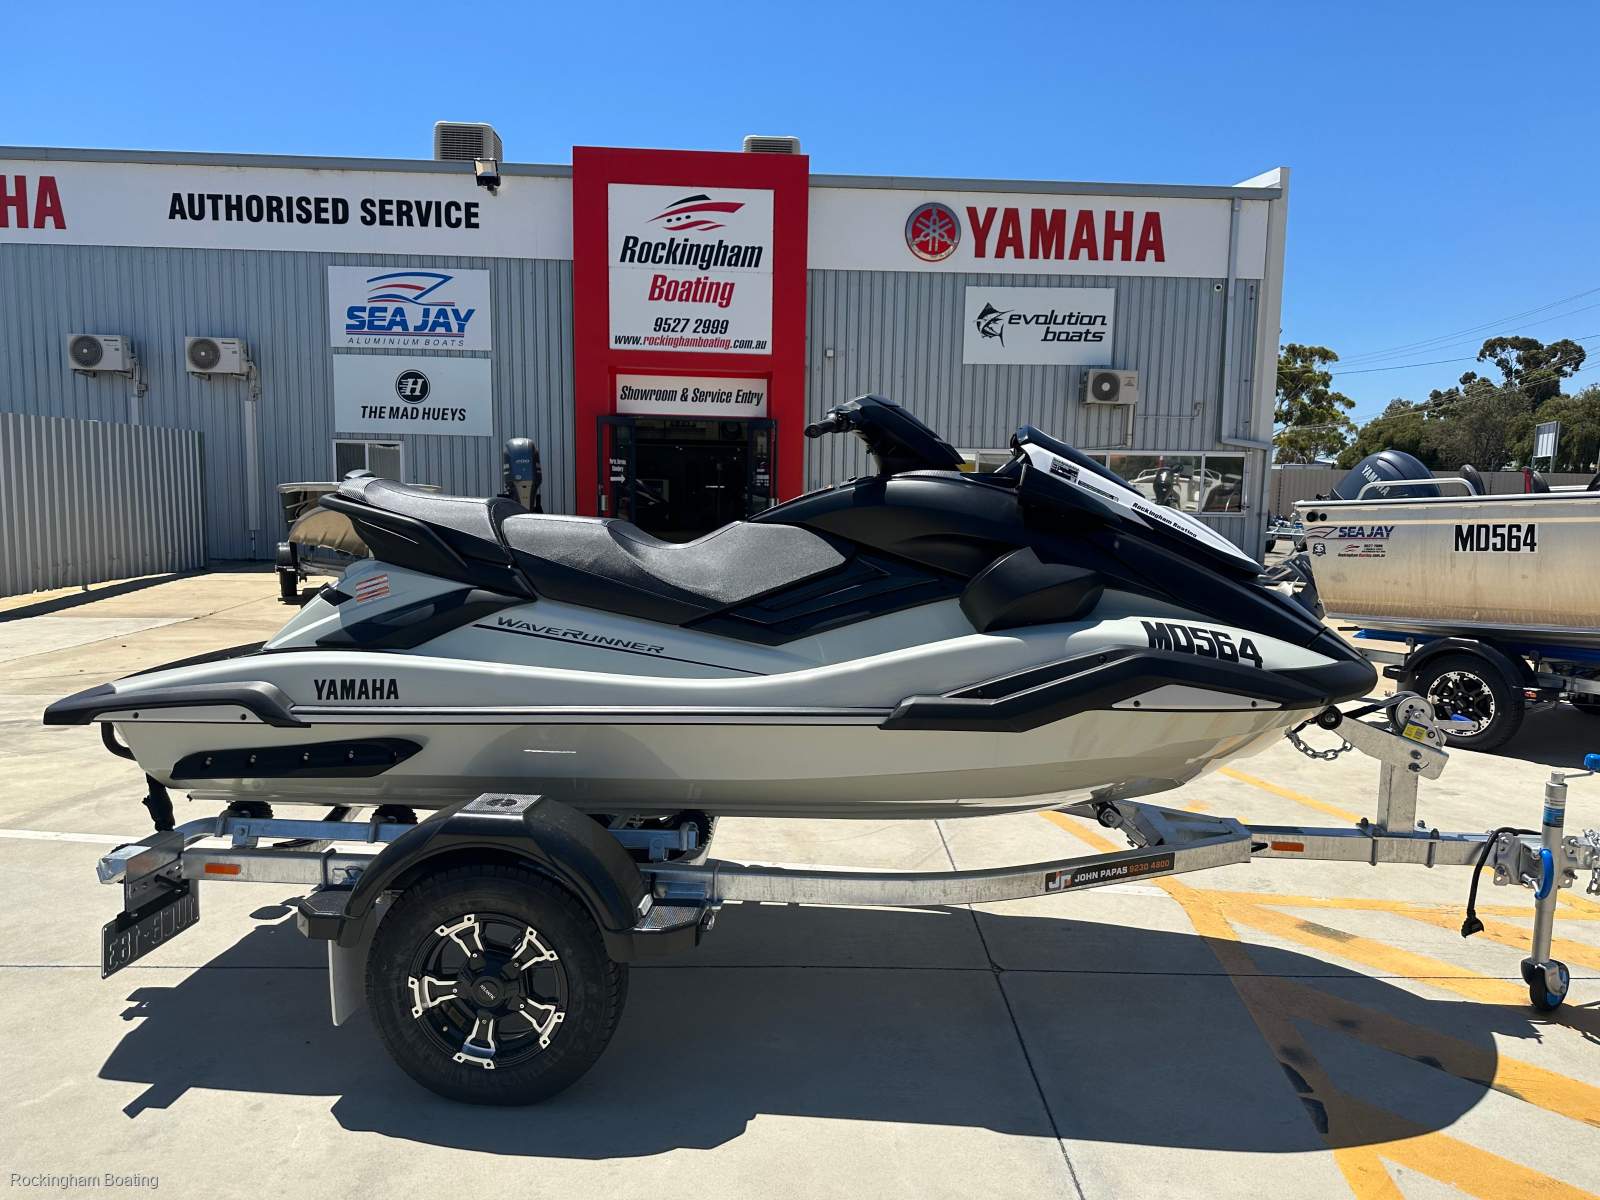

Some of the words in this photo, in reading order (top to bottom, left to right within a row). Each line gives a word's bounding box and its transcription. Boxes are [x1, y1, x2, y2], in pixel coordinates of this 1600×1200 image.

[168, 192, 349, 225] AUTHORISED
[360, 198, 480, 229] SERVICE
[966, 206, 1165, 263] YAMAHA
[619, 235, 763, 271] Rockingham
[648, 274, 736, 309] Boating
[345, 305, 410, 332] SEA
[413, 307, 476, 333] JAY
[653, 316, 690, 333] 9527
[692, 318, 729, 335] 2999
[1007, 309, 1107, 326] evolution
[347, 337, 419, 346] ALUMINIUM
[424, 338, 464, 347] BOATS
[614, 334, 767, 350] www.rockinghamboating.com.au
[1040, 326, 1106, 342] boats
[619, 385, 678, 402] Showroom
[679, 387, 689, 403] &
[691, 387, 732, 404] Service
[734, 388, 764, 407] Entry
[360, 405, 386, 419] THE
[388, 406, 419, 420] MAD
[421, 407, 467, 421] HUEYS
[1361, 464, 1391, 497] YAMA
[1132, 502, 1173, 525] Rockingham
[1338, 526, 1365, 538] SEA
[1366, 525, 1395, 538] JAY
[1454, 523, 1537, 552] MD564
[497, 616, 665, 654] WAVERUNNER
[1141, 620, 1264, 669] MD564
[314, 678, 399, 701] YAMAHA
[1074, 873, 1099, 882] JOHN
[1100, 866, 1128, 878] PAPAS
[1129, 864, 1149, 873] 9230
[1150, 859, 1170, 870] 4800
